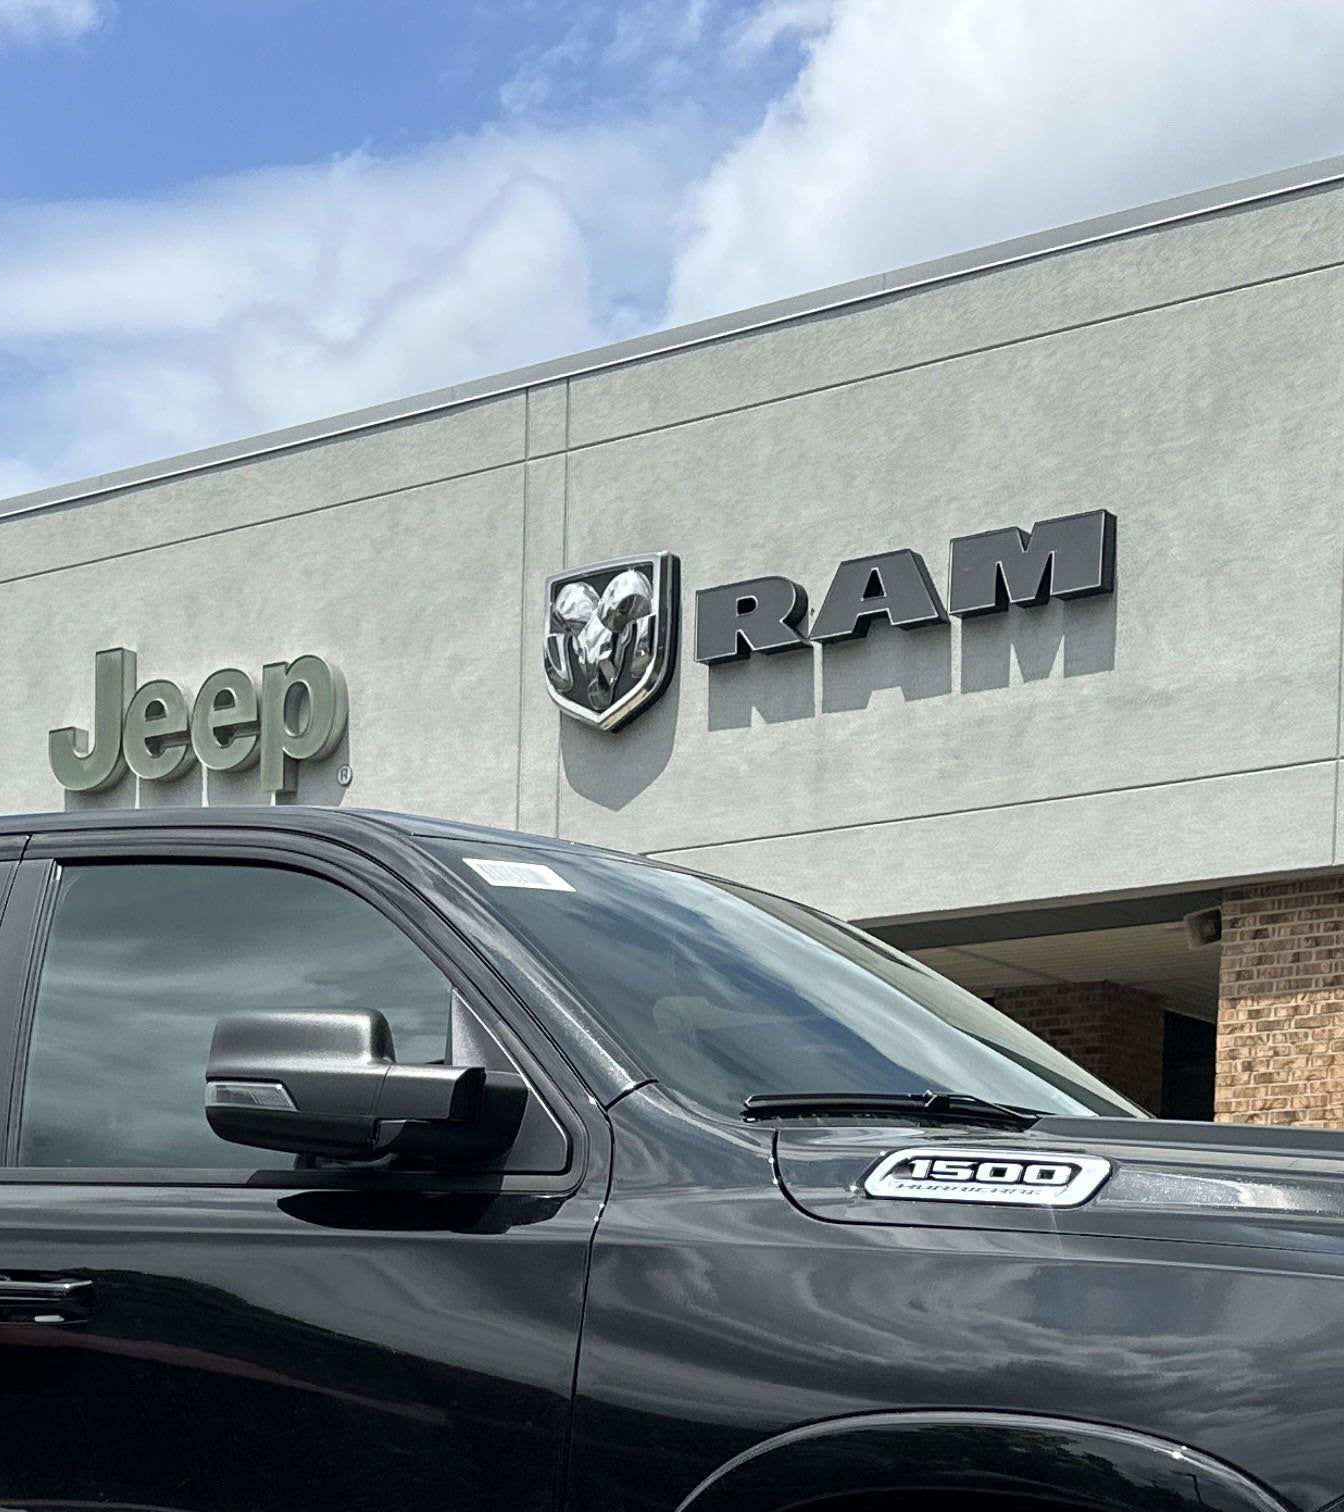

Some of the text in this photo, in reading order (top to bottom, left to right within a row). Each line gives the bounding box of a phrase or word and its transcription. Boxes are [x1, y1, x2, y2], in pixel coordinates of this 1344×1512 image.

[695, 509, 1117, 665] RAM
[49, 647, 350, 795] Jeep
[909, 1158, 1074, 1185] 1500
